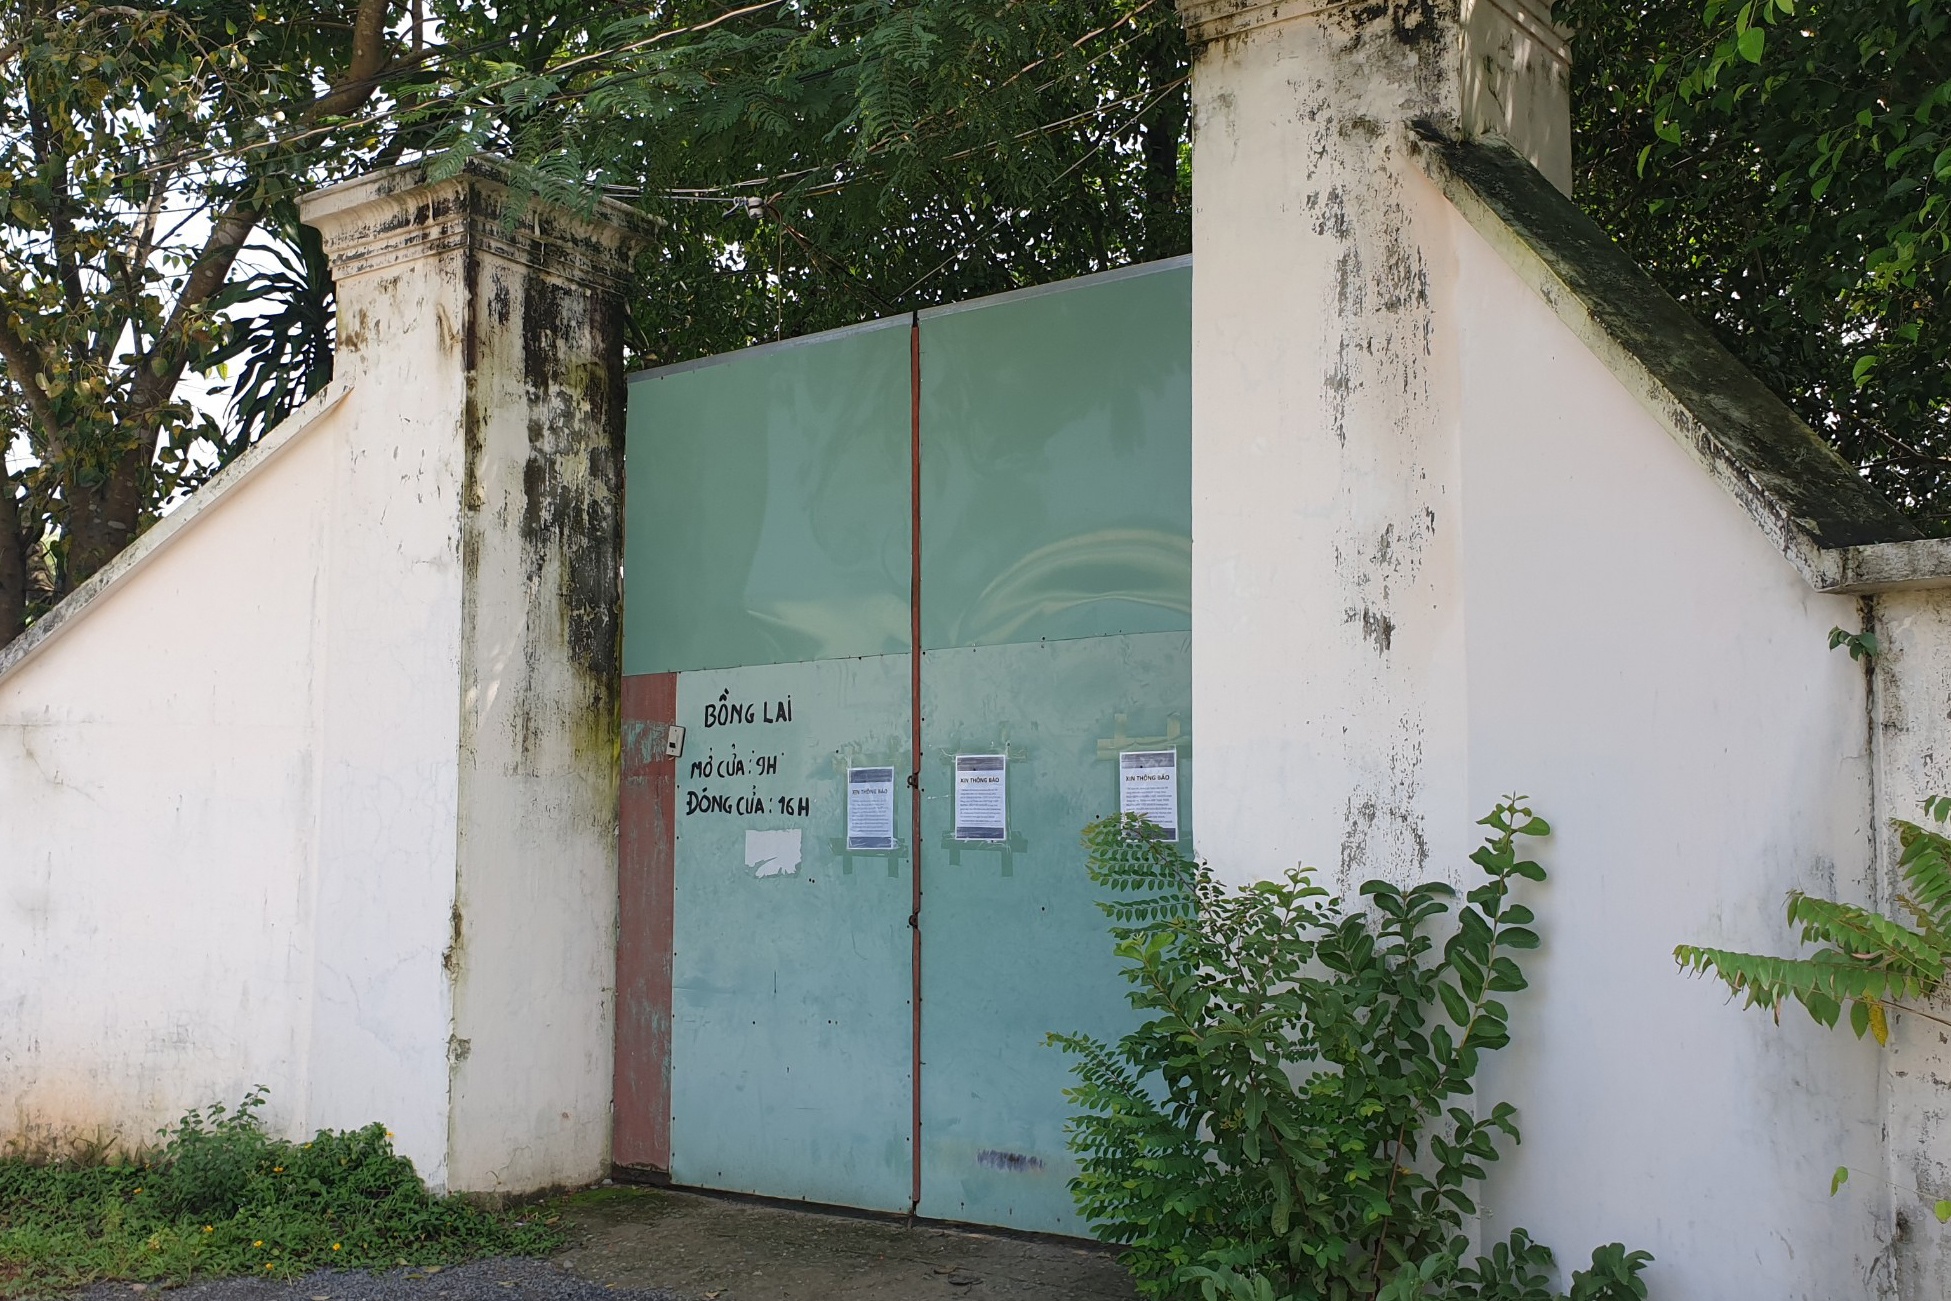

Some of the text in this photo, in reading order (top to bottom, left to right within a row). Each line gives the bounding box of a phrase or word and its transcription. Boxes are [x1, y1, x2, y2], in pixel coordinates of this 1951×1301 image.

[704, 688, 755, 728] BỒNG
[690, 747, 713, 779] MỞ
[756, 755, 778, 776] 9H
[686, 786, 732, 816] ĐÓNG
